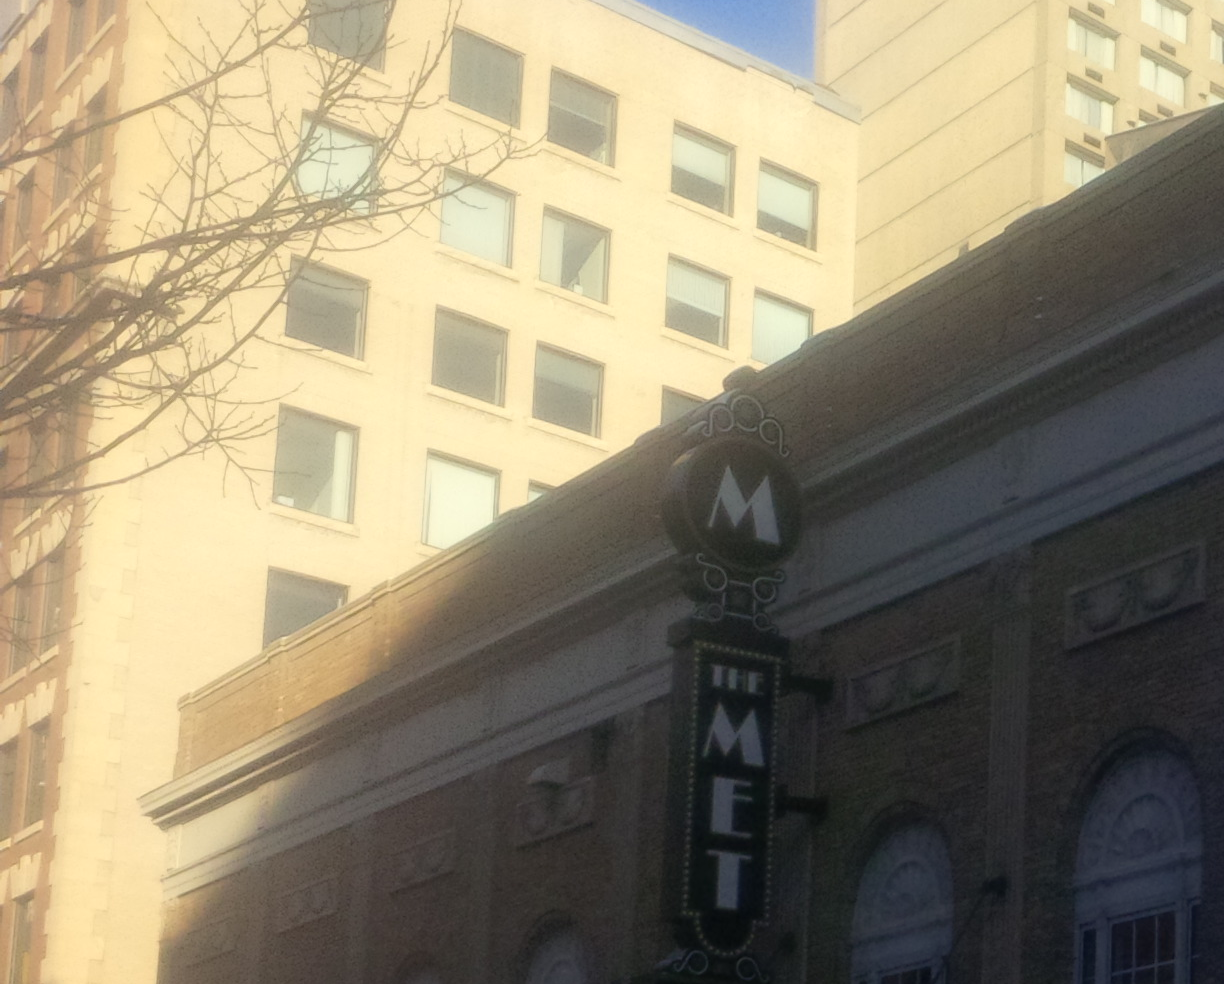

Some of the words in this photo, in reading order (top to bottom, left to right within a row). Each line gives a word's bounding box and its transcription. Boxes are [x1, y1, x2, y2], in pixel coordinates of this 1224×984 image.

[707, 465, 780, 544] M
[710, 664, 765, 695] THE
[703, 700, 765, 910] MET
